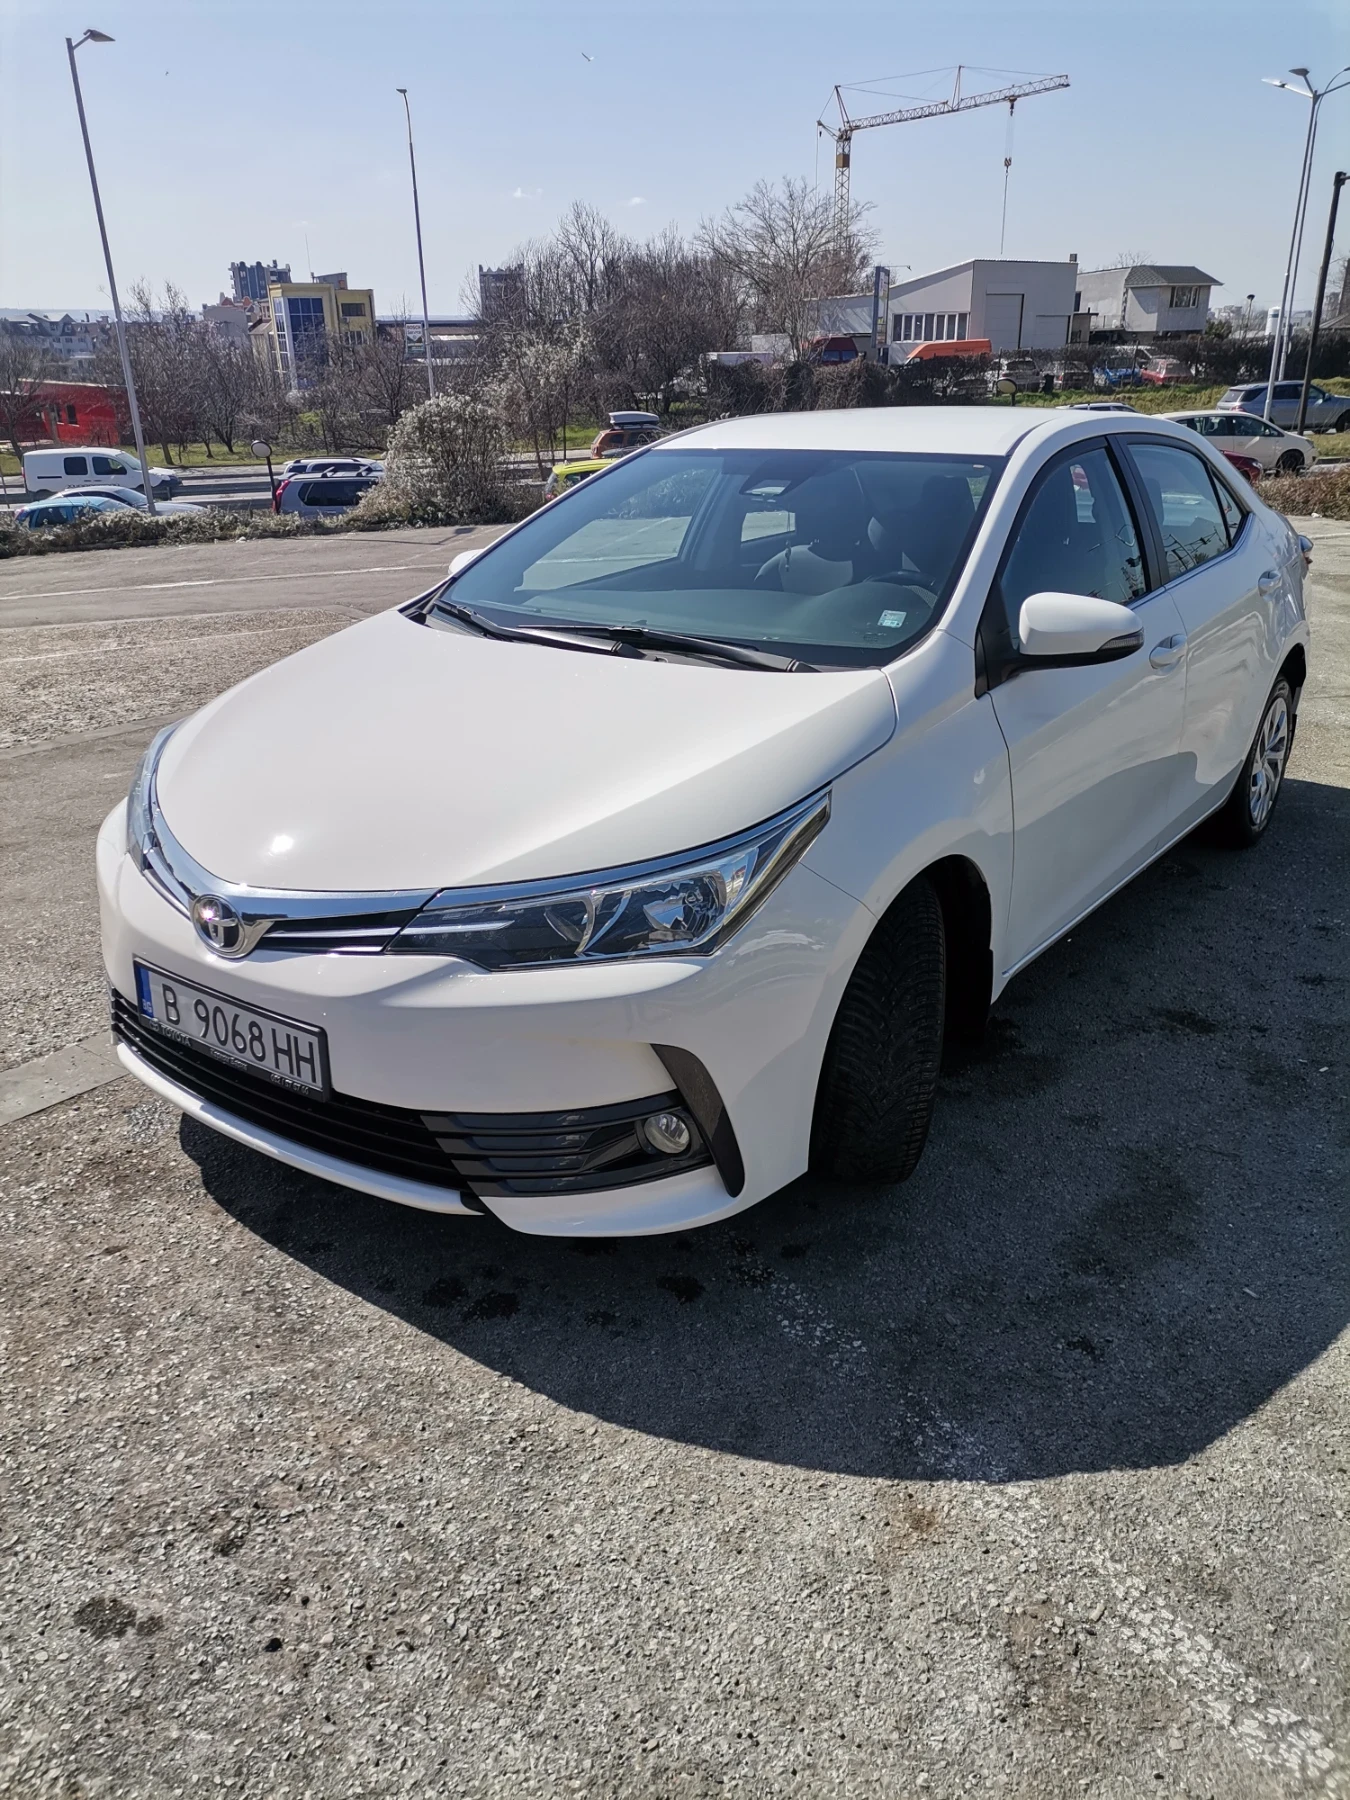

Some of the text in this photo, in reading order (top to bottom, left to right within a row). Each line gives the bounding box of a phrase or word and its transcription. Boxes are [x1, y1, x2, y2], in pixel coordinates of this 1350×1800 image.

[160, 1023, 191, 1047] TOYOTA
[162, 983, 181, 1026] B
[193, 998, 266, 1063] 9068
[271, 1028, 317, 1084] HH
